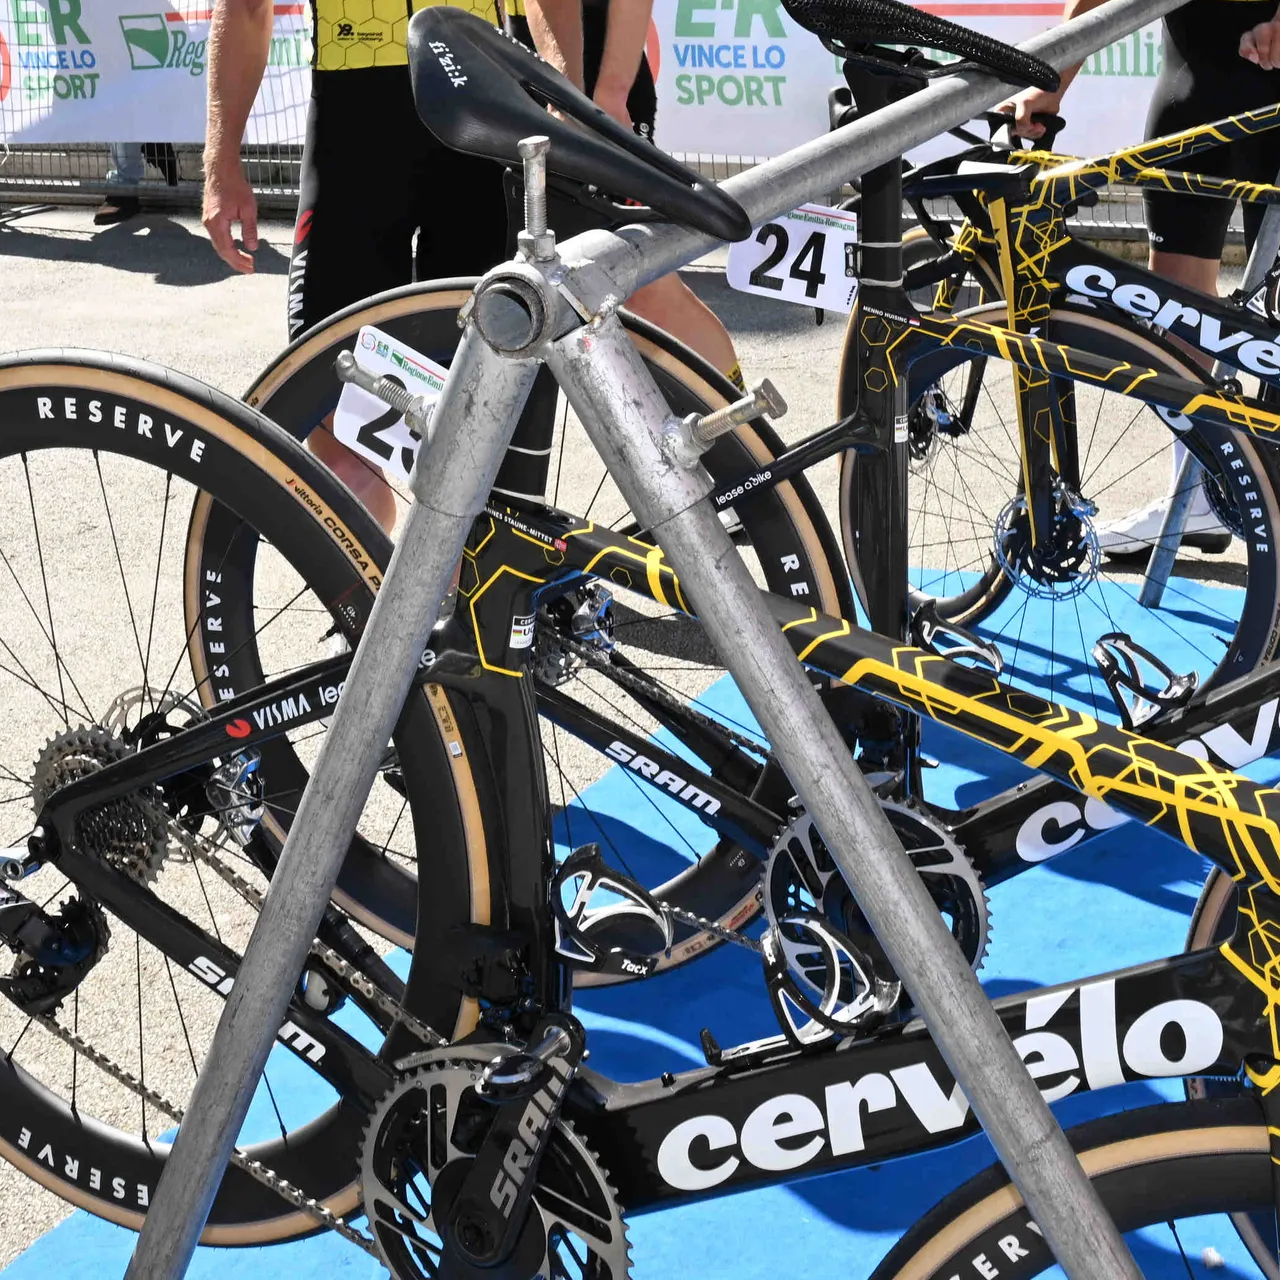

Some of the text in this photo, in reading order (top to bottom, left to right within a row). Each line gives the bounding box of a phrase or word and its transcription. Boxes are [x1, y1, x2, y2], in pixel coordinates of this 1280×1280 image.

[18, 50, 96, 71] VINCE LO
[673, 43, 786, 69] VINCE LO
[23, 73, 100, 100] SPORT
[676, 74, 787, 107] SPORT
[804, 214, 855, 231] Emilia-Romagna
[749, 223, 826, 299] 24
[290, 249, 308, 330] VISMA
[863, 305, 908, 323] MENNO HUISING
[402, 360, 429, 385] Regione
[37, 396, 207, 464] RESERVE
[715, 485, 744, 506] lease
[1220, 441, 1268, 554] RESERVE
[294, 488, 369, 571] vittoria CORSA
[503, 514, 553, 544] STAUNE-MITTET
[252, 697, 311, 730] VISMA
[605, 741, 721, 816] SRAM
[620, 958, 648, 976] Tacx
[657, 980, 1223, 1191] cervélo
